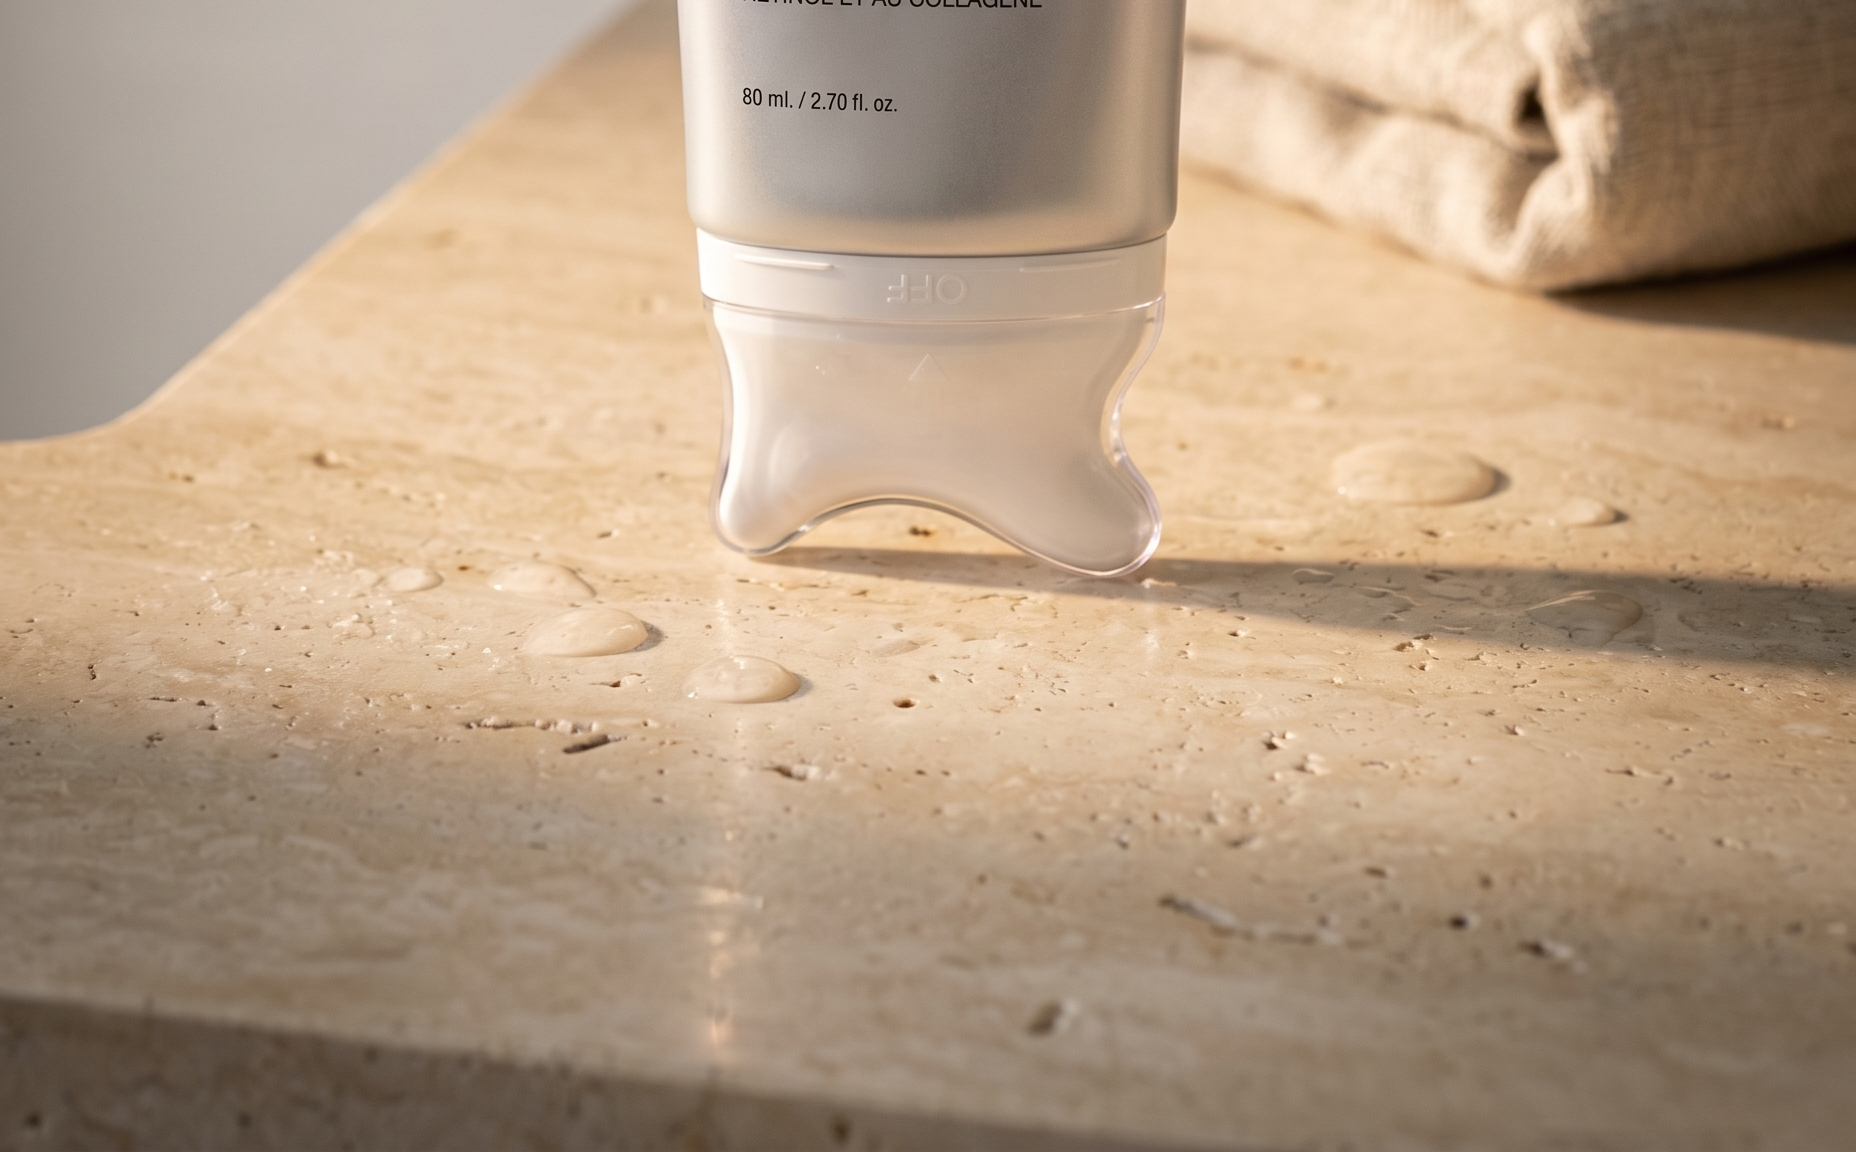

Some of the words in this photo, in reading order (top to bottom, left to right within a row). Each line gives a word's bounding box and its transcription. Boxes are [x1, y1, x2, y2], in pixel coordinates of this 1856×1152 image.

[743, 88, 762, 105] 80
[769, 91, 792, 108] ml.
[799, 92, 806, 108] /
[811, 92, 847, 110] 2.70
[852, 94, 868, 111] fl.
[874, 99, 897, 111] oz.
[887, 274, 968, 304] OFF
